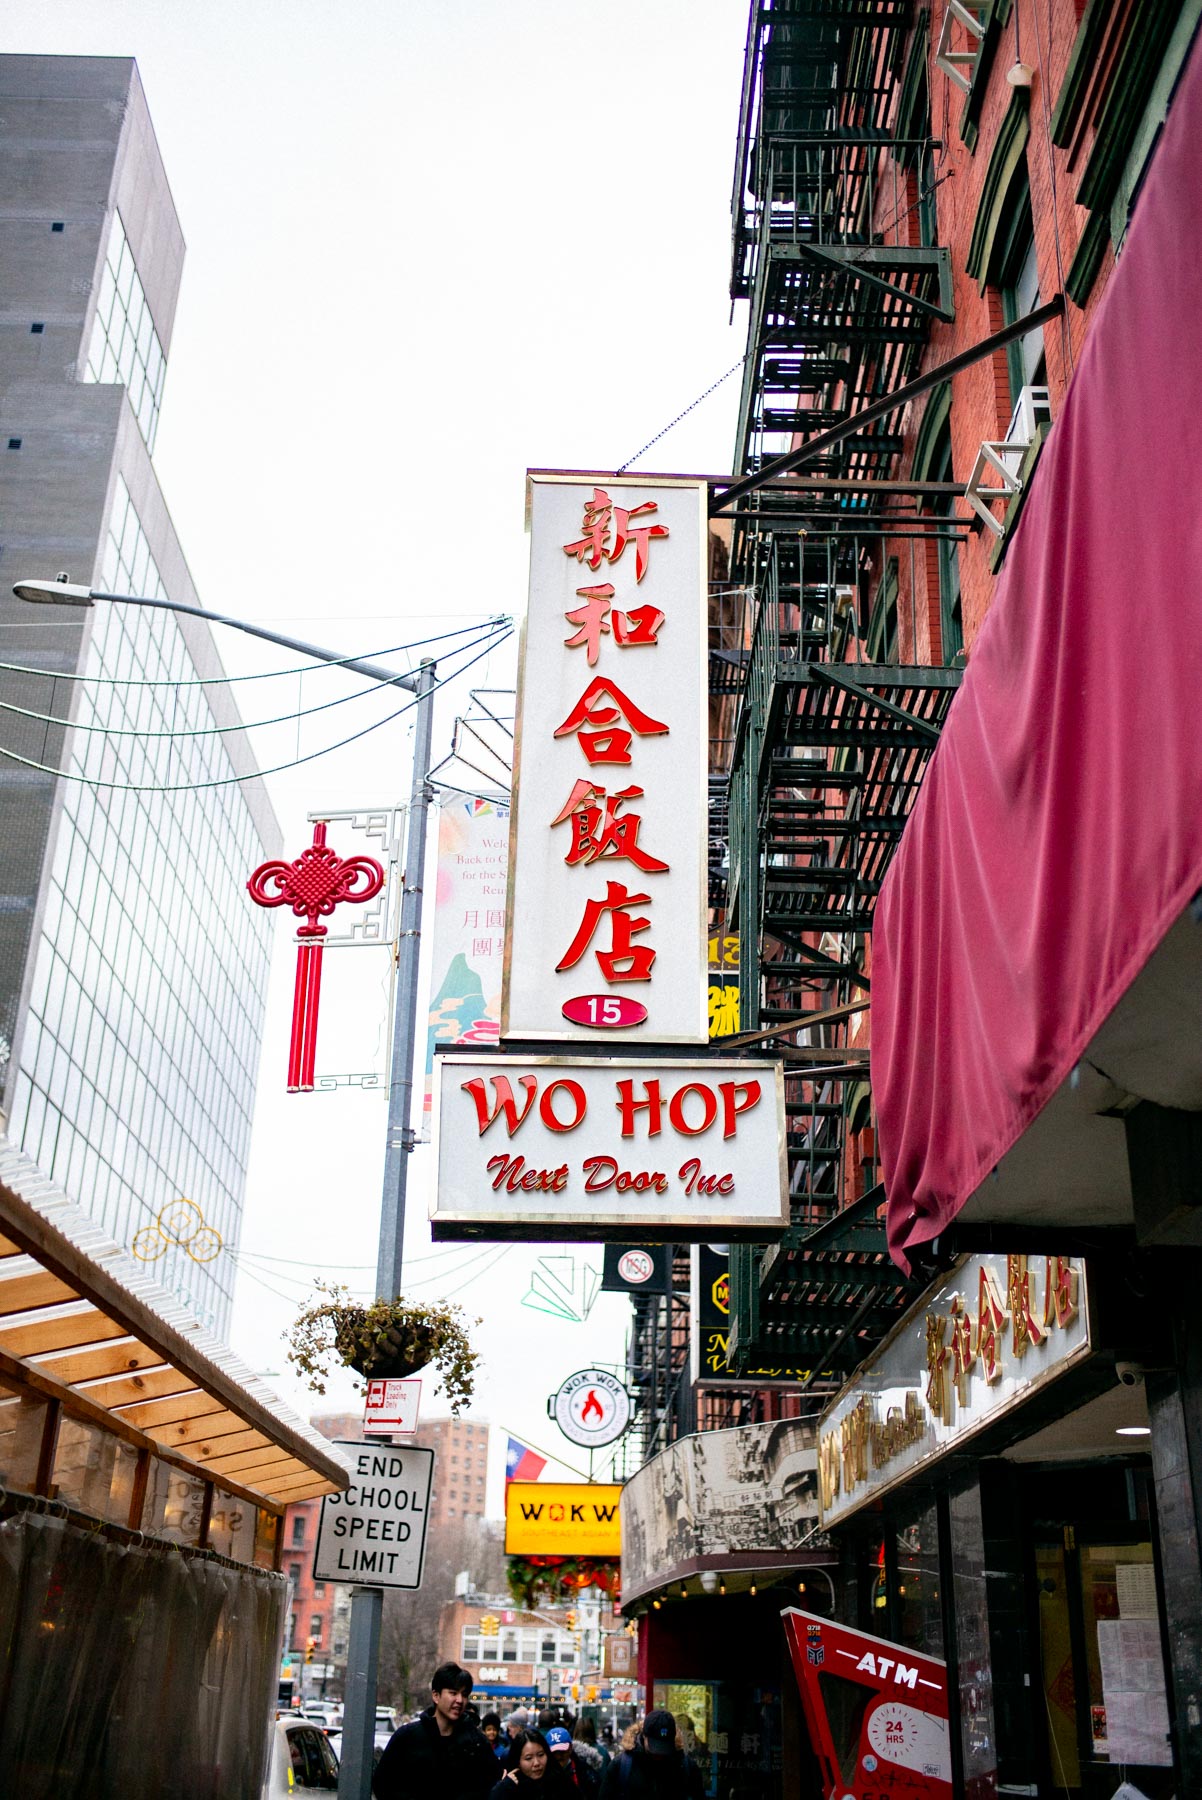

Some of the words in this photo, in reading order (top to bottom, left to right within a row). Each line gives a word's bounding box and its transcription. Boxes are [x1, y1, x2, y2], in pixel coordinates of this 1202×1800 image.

[551, 488, 670, 983] 新和合飯店
[457, 855, 482, 864] Back
[485, 856, 495, 864] to
[462, 871, 476, 880] for
[480, 871, 496, 880] the
[463, 910, 506, 929] 月圓
[588, 998, 621, 1024] 15
[460, 1074, 587, 1138] WO
[615, 1078, 762, 1140] HOP
[486, 1154, 569, 1193] Next
[582, 1155, 668, 1193] Door
[678, 1157, 735, 1195] Inc
[562, 1373, 590, 1395] WOK
[595, 1373, 622, 1396] WOK
[357, 1456, 403, 1478] END
[328, 1486, 423, 1512] SCHOOL
[520, 1503, 585, 1521] WOK
[333, 1516, 411, 1542] SPEED
[338, 1549, 399, 1574] LIMIT
[856, 1652, 919, 1689] ATM
[885, 1721, 903, 1733] 24
[886, 1735, 905, 1744] HRS
